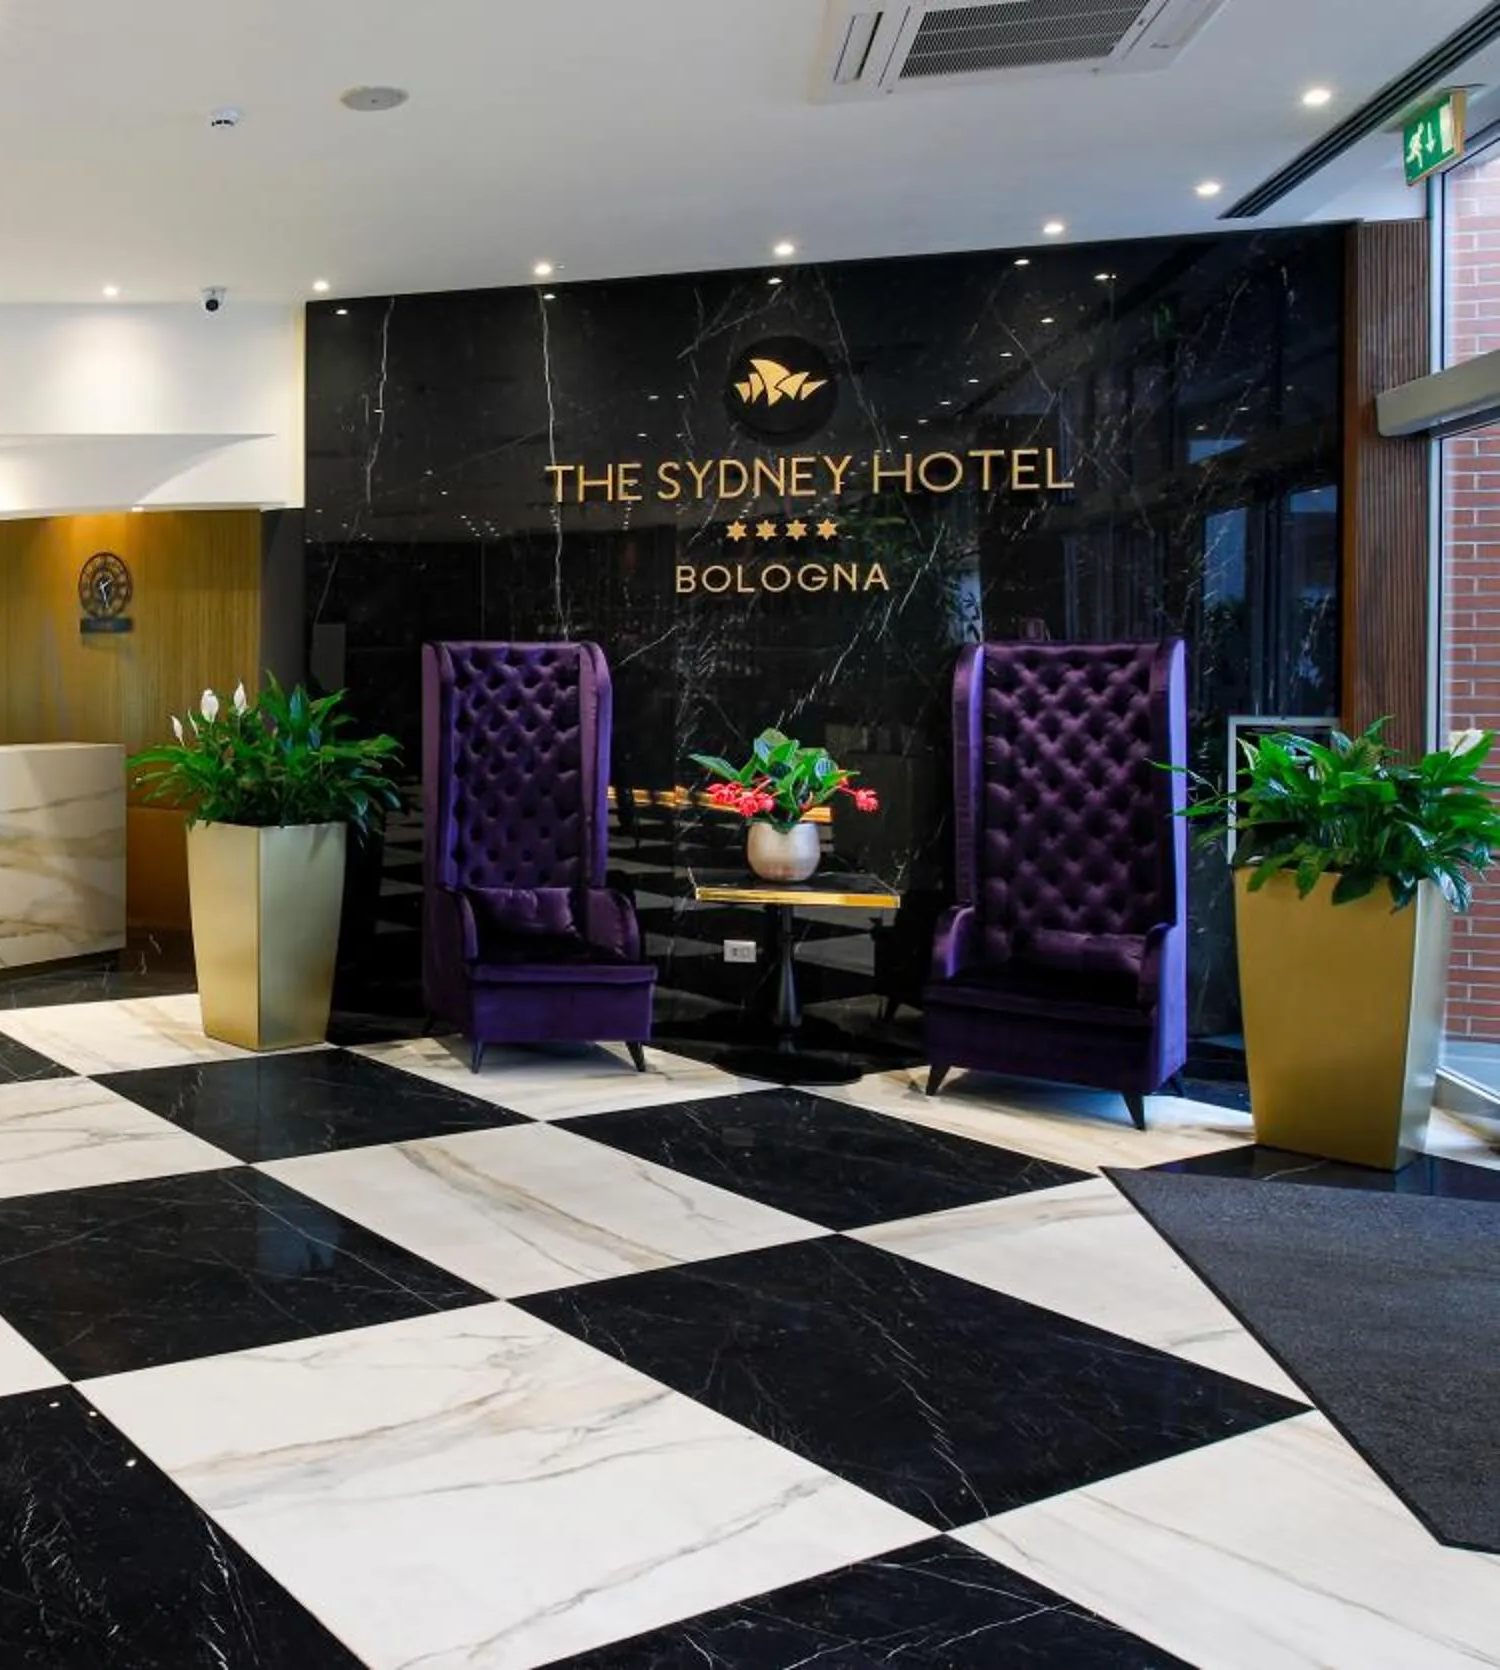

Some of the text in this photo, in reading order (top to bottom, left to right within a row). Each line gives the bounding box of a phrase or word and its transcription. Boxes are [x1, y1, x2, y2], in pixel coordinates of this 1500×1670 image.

[545, 447, 1075, 503] THE SYDNEY HOTEL
[675, 563, 891, 593] BOLOGNA
